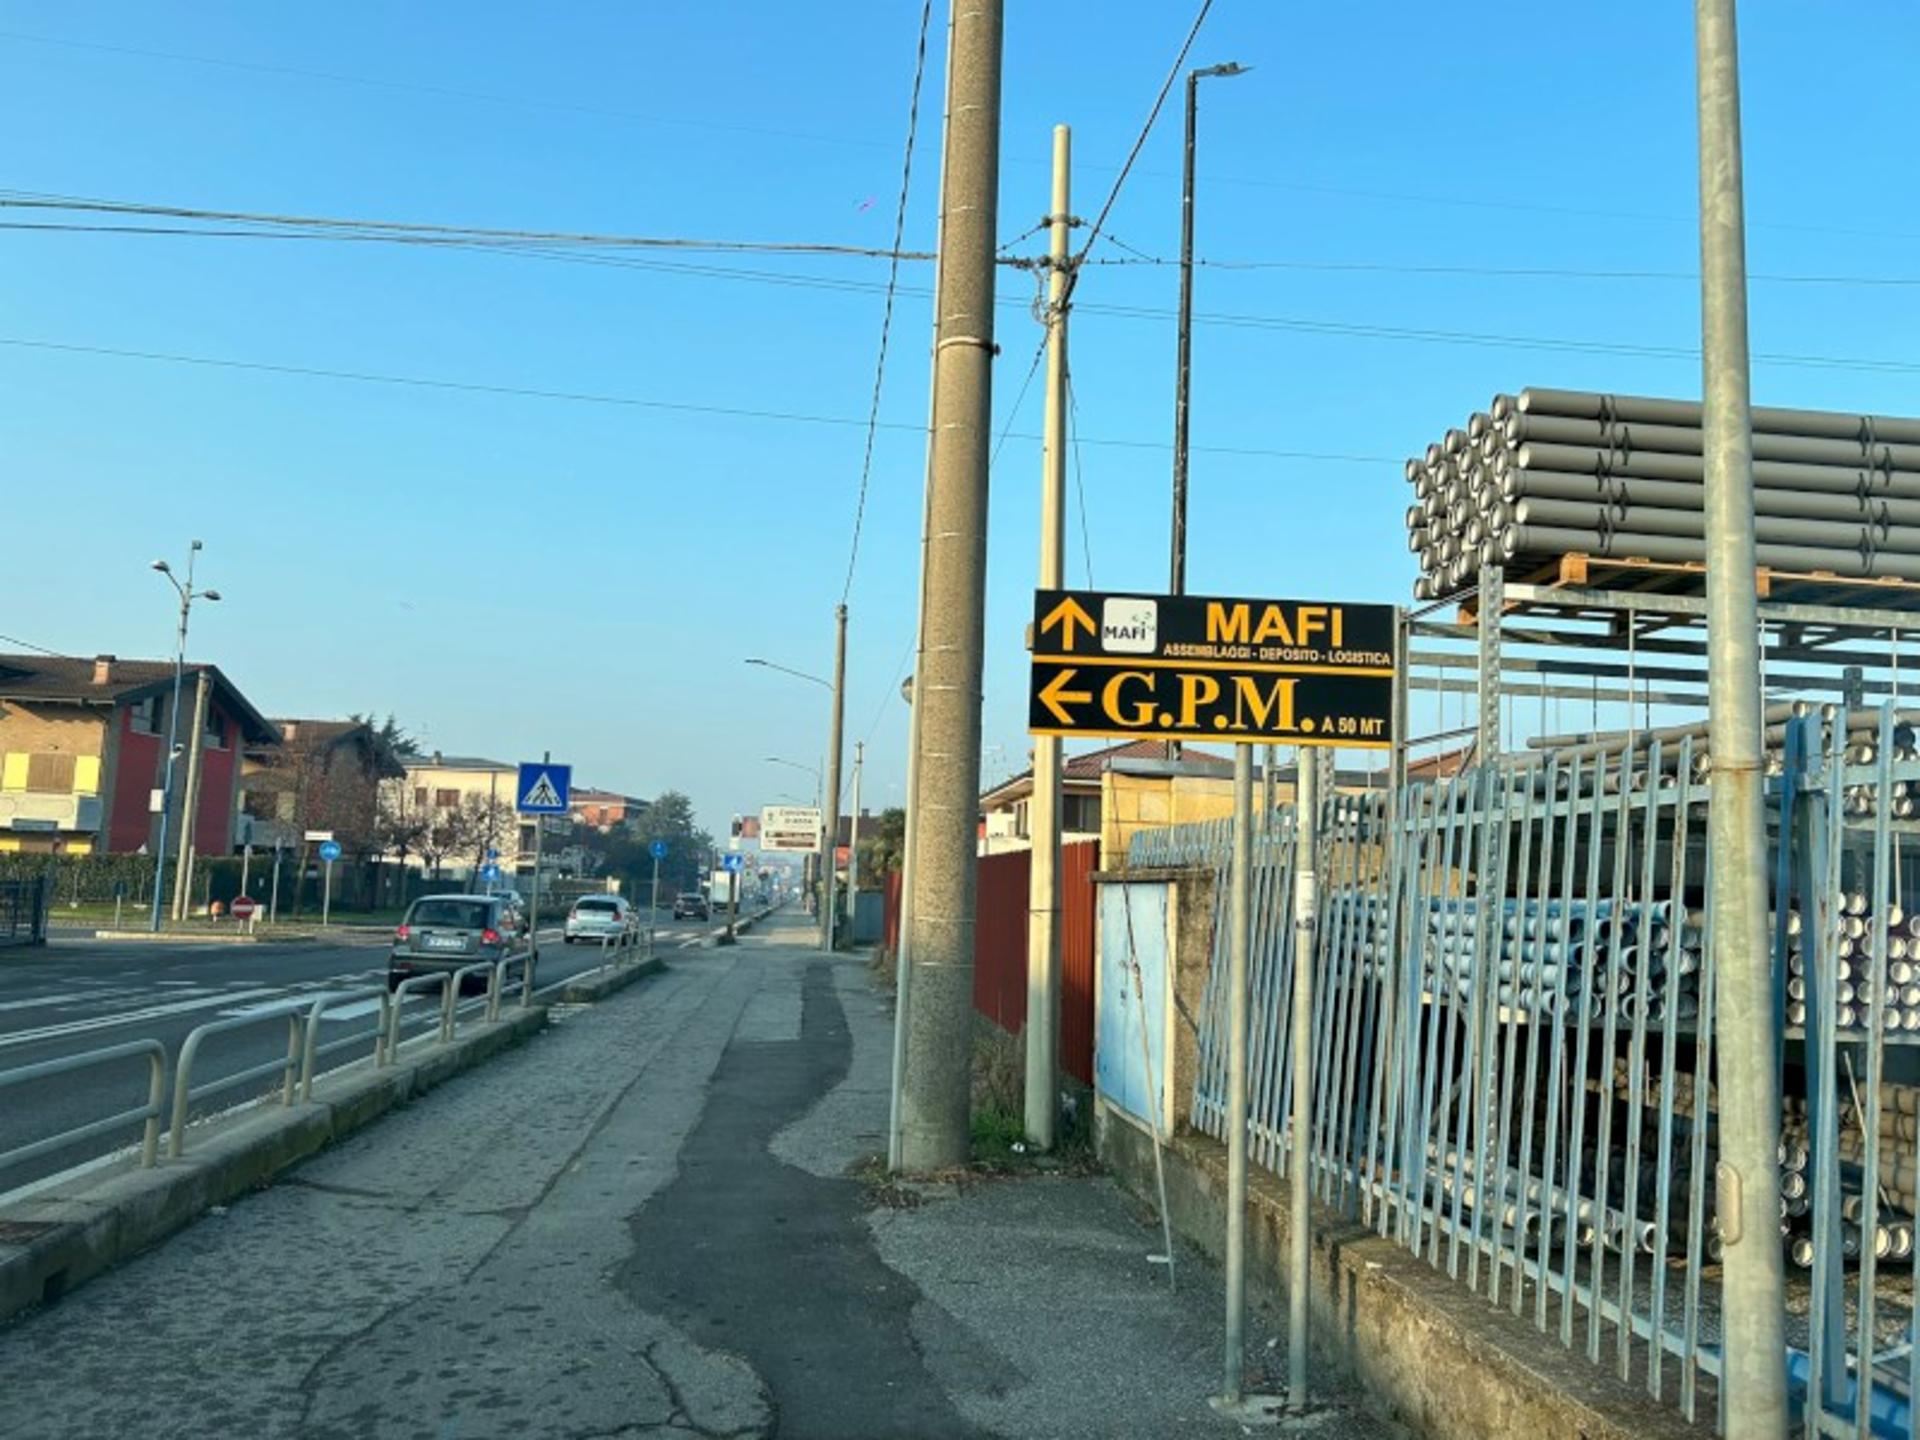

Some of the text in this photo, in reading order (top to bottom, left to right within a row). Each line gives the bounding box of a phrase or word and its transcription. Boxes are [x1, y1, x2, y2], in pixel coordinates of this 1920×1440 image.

[1206, 602, 1343, 648] MAFI
[1163, 642, 1251, 659] ASSEMBLAGGI
[1259, 646, 1319, 662] DEPOSITO
[1328, 650, 1391, 665] LOGISTICA
[1102, 671, 1315, 733] G.P.M.
[1321, 715, 1384, 736] A 50 MT
